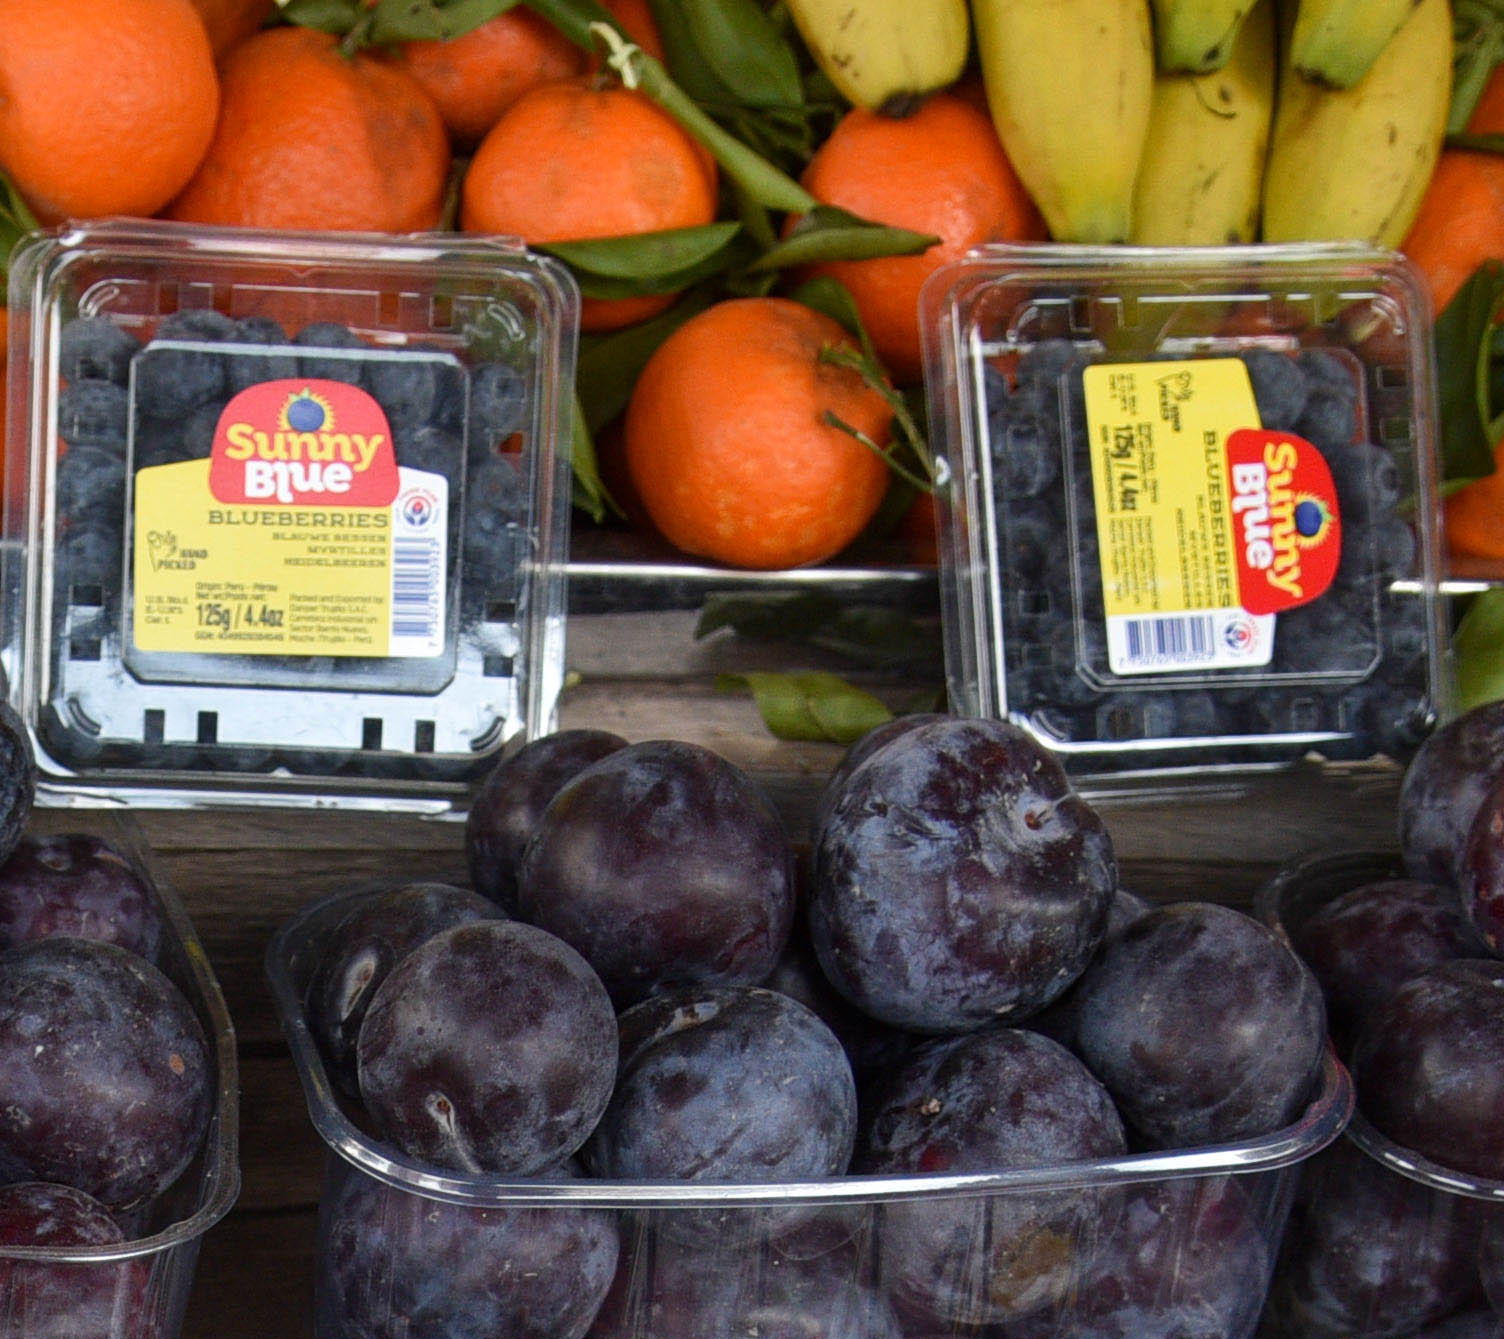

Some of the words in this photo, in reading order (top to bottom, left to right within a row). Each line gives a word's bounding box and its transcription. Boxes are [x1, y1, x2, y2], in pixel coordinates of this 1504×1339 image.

[225, 422, 385, 472] Sunny
[244, 461, 354, 503] Blue
[208, 510, 388, 528] BLUEBERRIES
[1204, 430, 1230, 608] BLUEBERRIES
[1231, 463, 1274, 569] Blue
[1263, 443, 1304, 598] Sunny
[196, 604, 230, 630] 125g
[244, 605, 284, 628] 4.4oz
